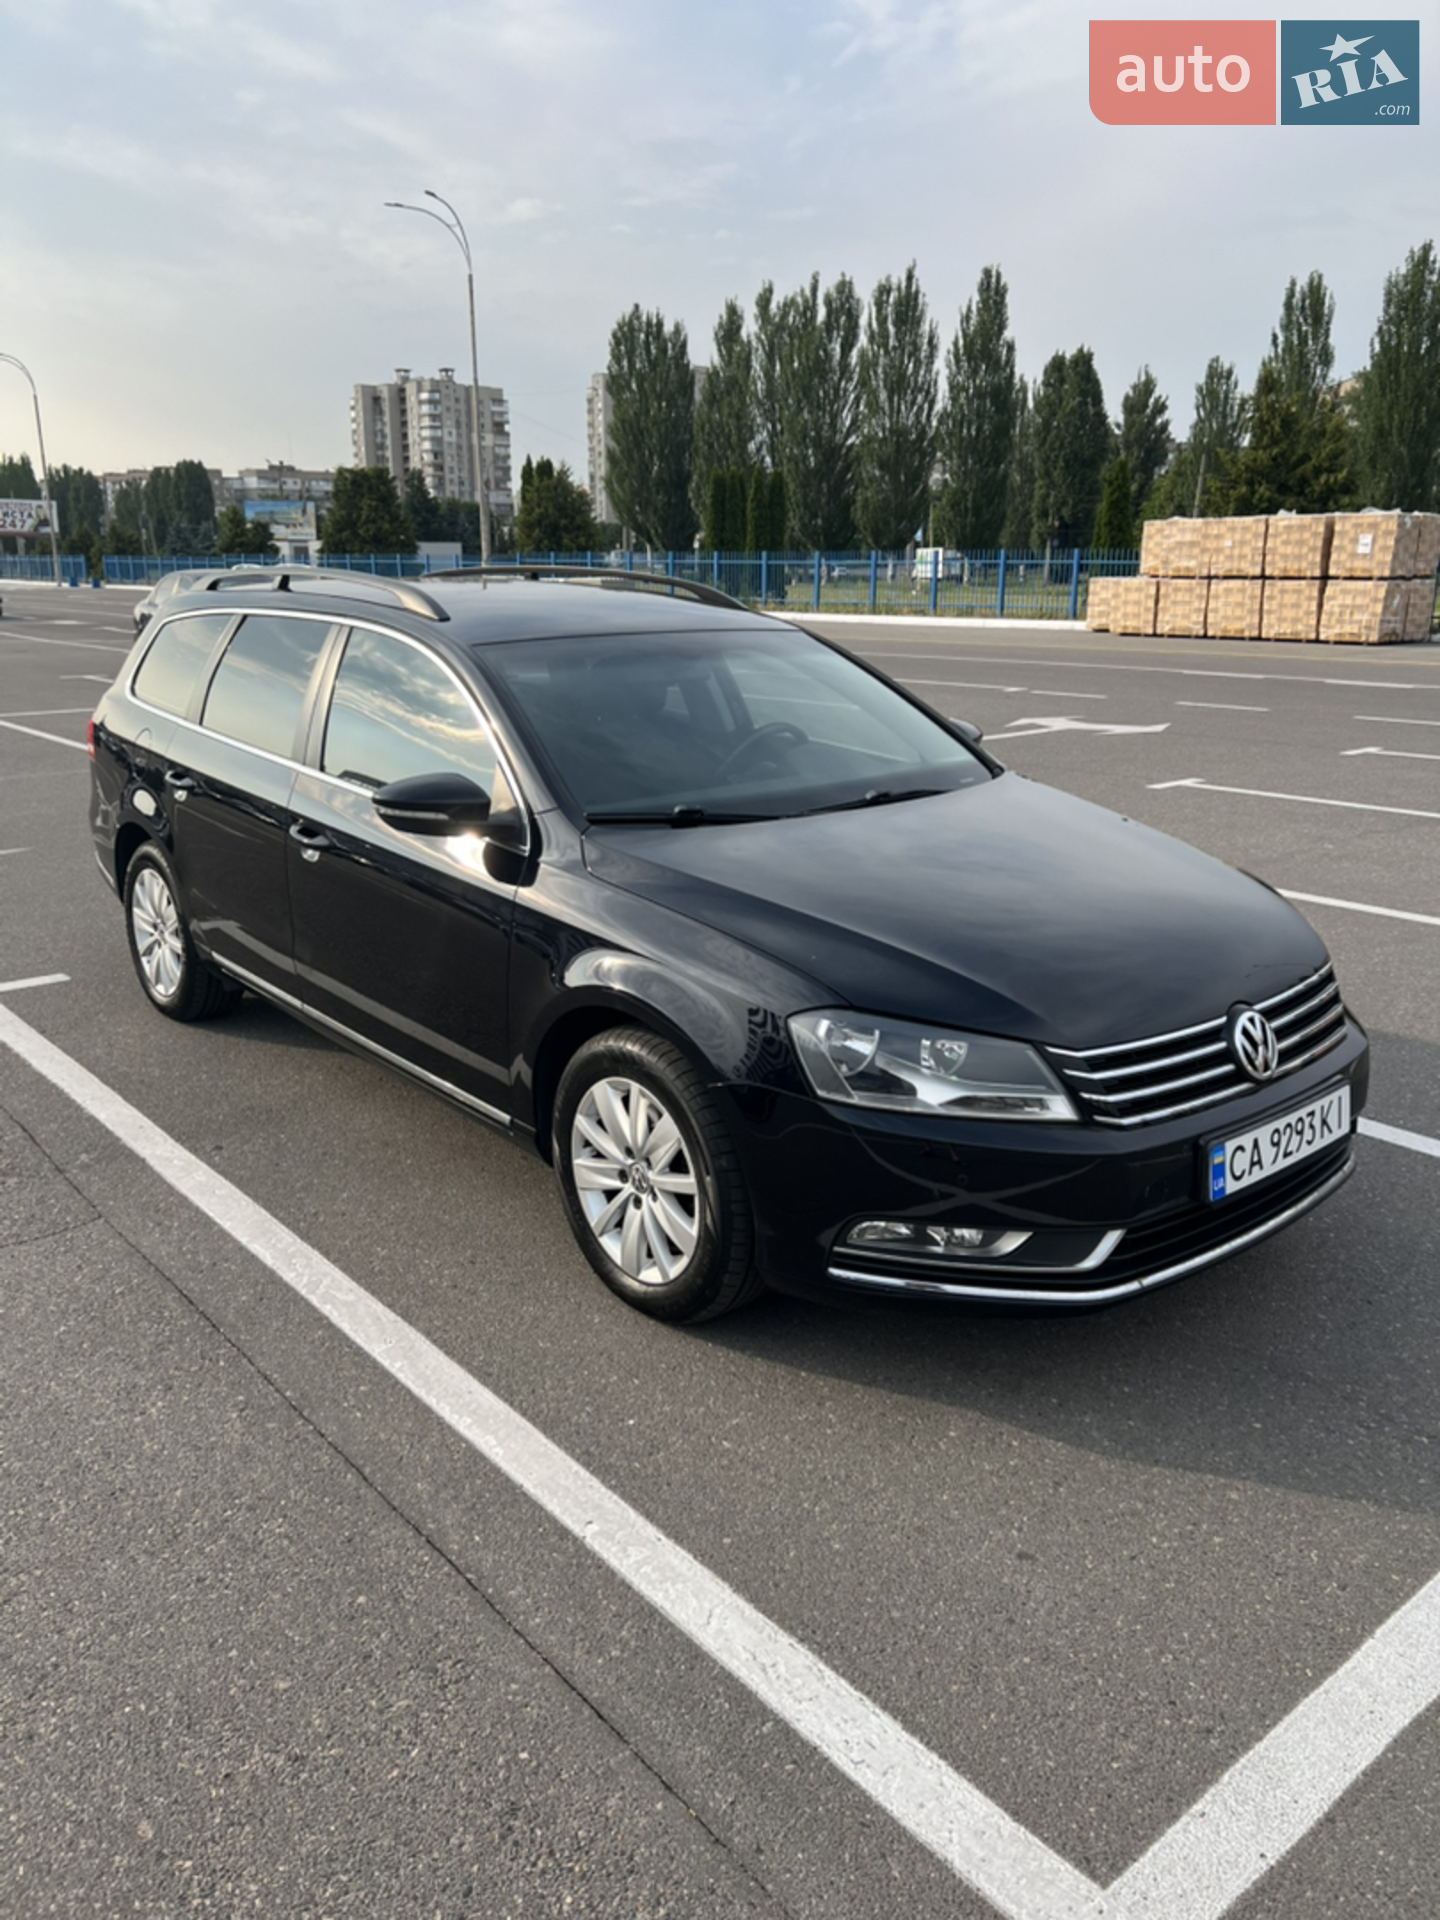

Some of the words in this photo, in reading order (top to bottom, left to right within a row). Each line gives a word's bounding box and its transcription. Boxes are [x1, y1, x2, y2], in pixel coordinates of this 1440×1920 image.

[1229, 1137, 1263, 1182] CA
[1270, 1109, 1316, 1166] 9293
[1320, 1095, 1342, 1139] KI
